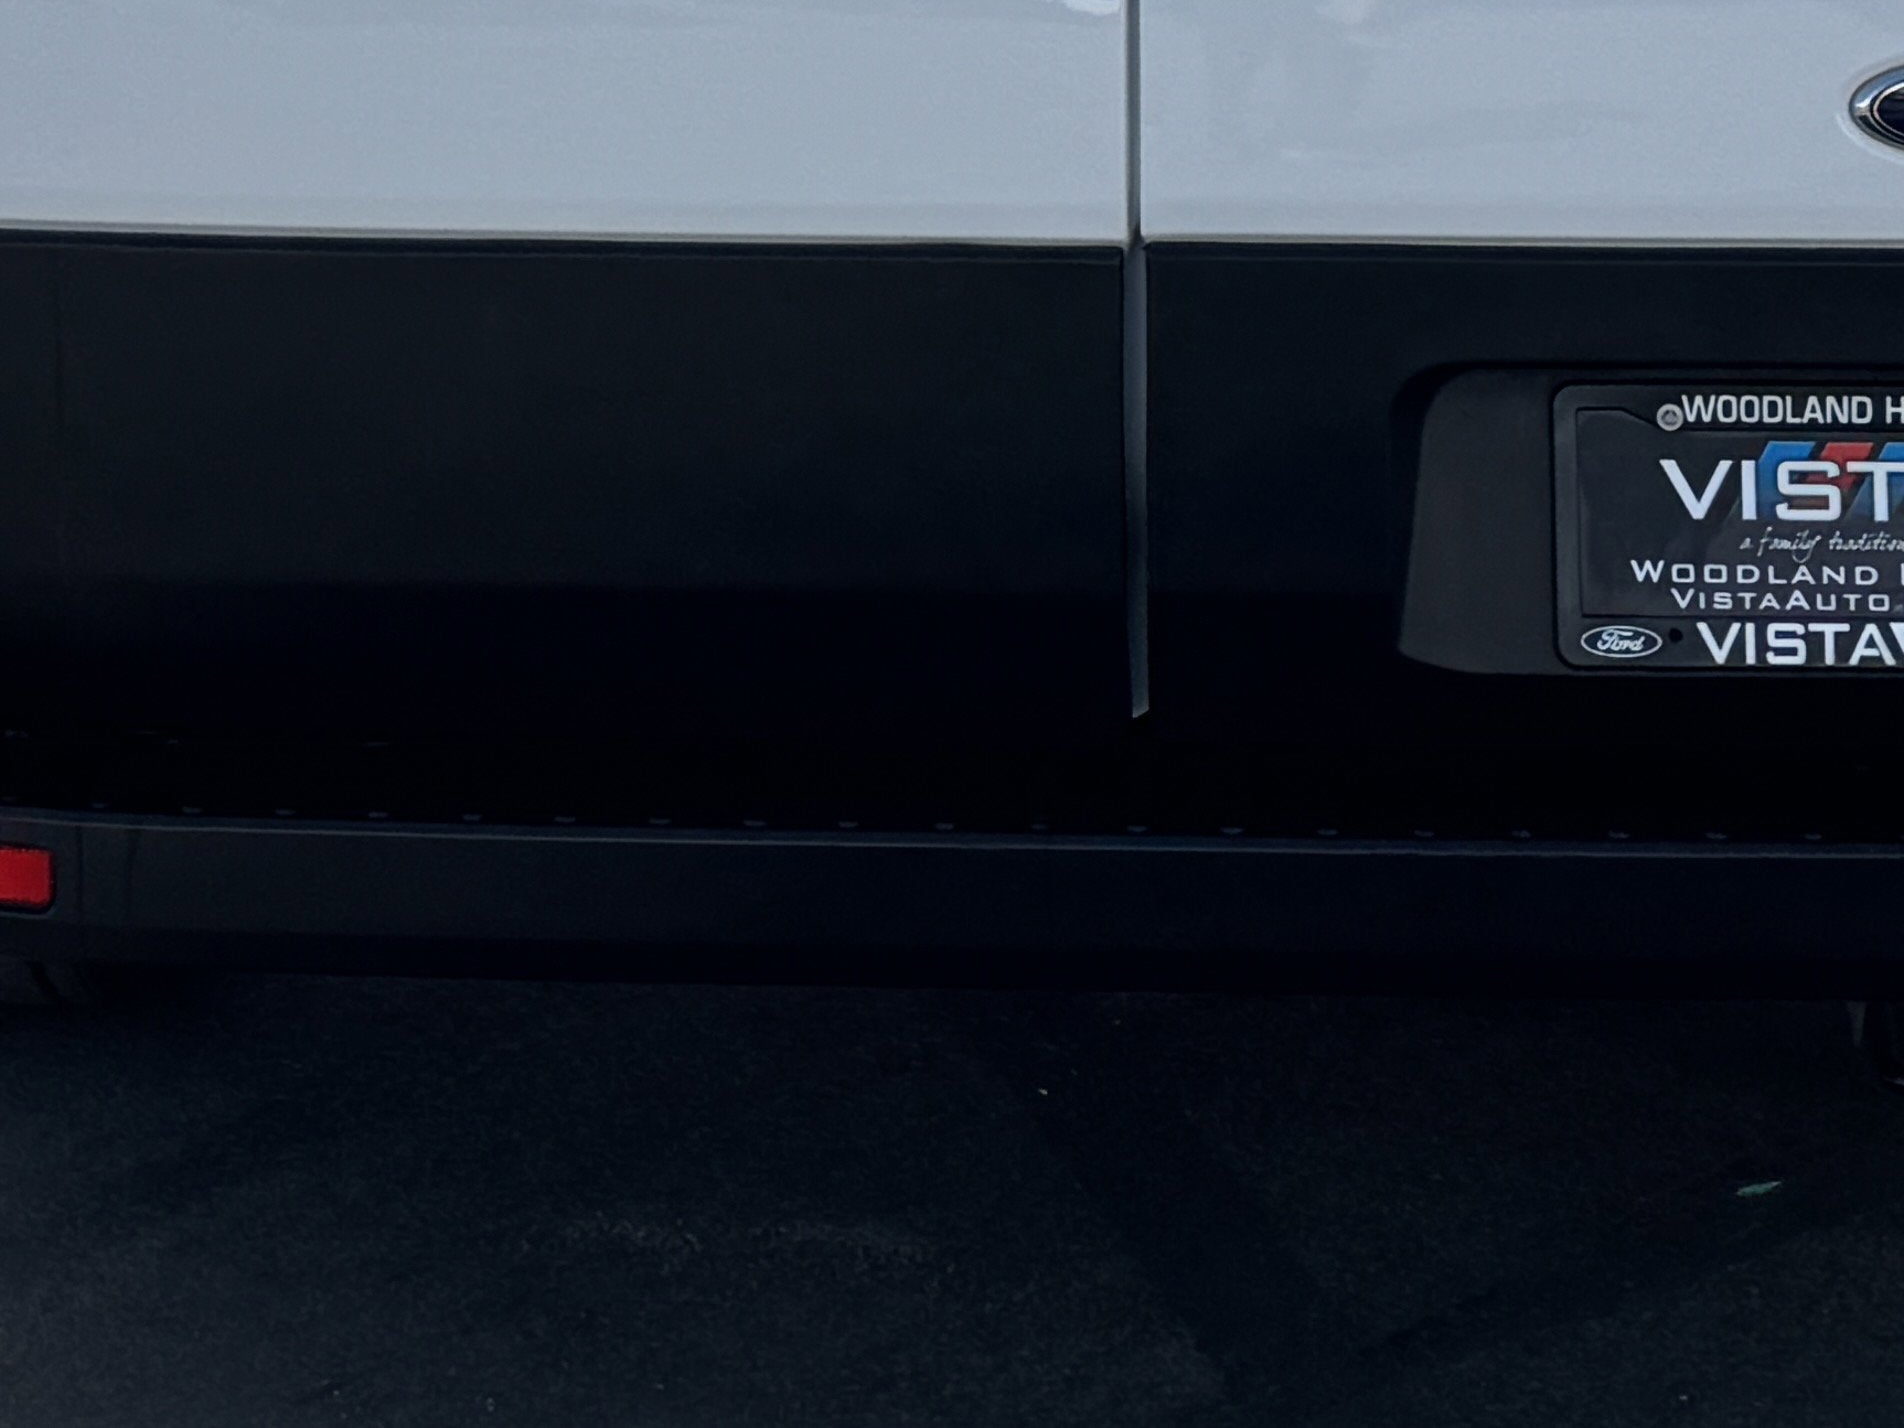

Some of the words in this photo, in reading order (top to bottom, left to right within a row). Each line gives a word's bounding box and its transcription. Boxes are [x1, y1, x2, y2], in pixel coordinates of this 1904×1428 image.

[1681, 394, 1873, 425] WOODLAND
[1630, 559, 1879, 587] WOODLAND
[1596, 629, 1645, 653] Ford
[1696, 622, 1898, 666] VISTA
